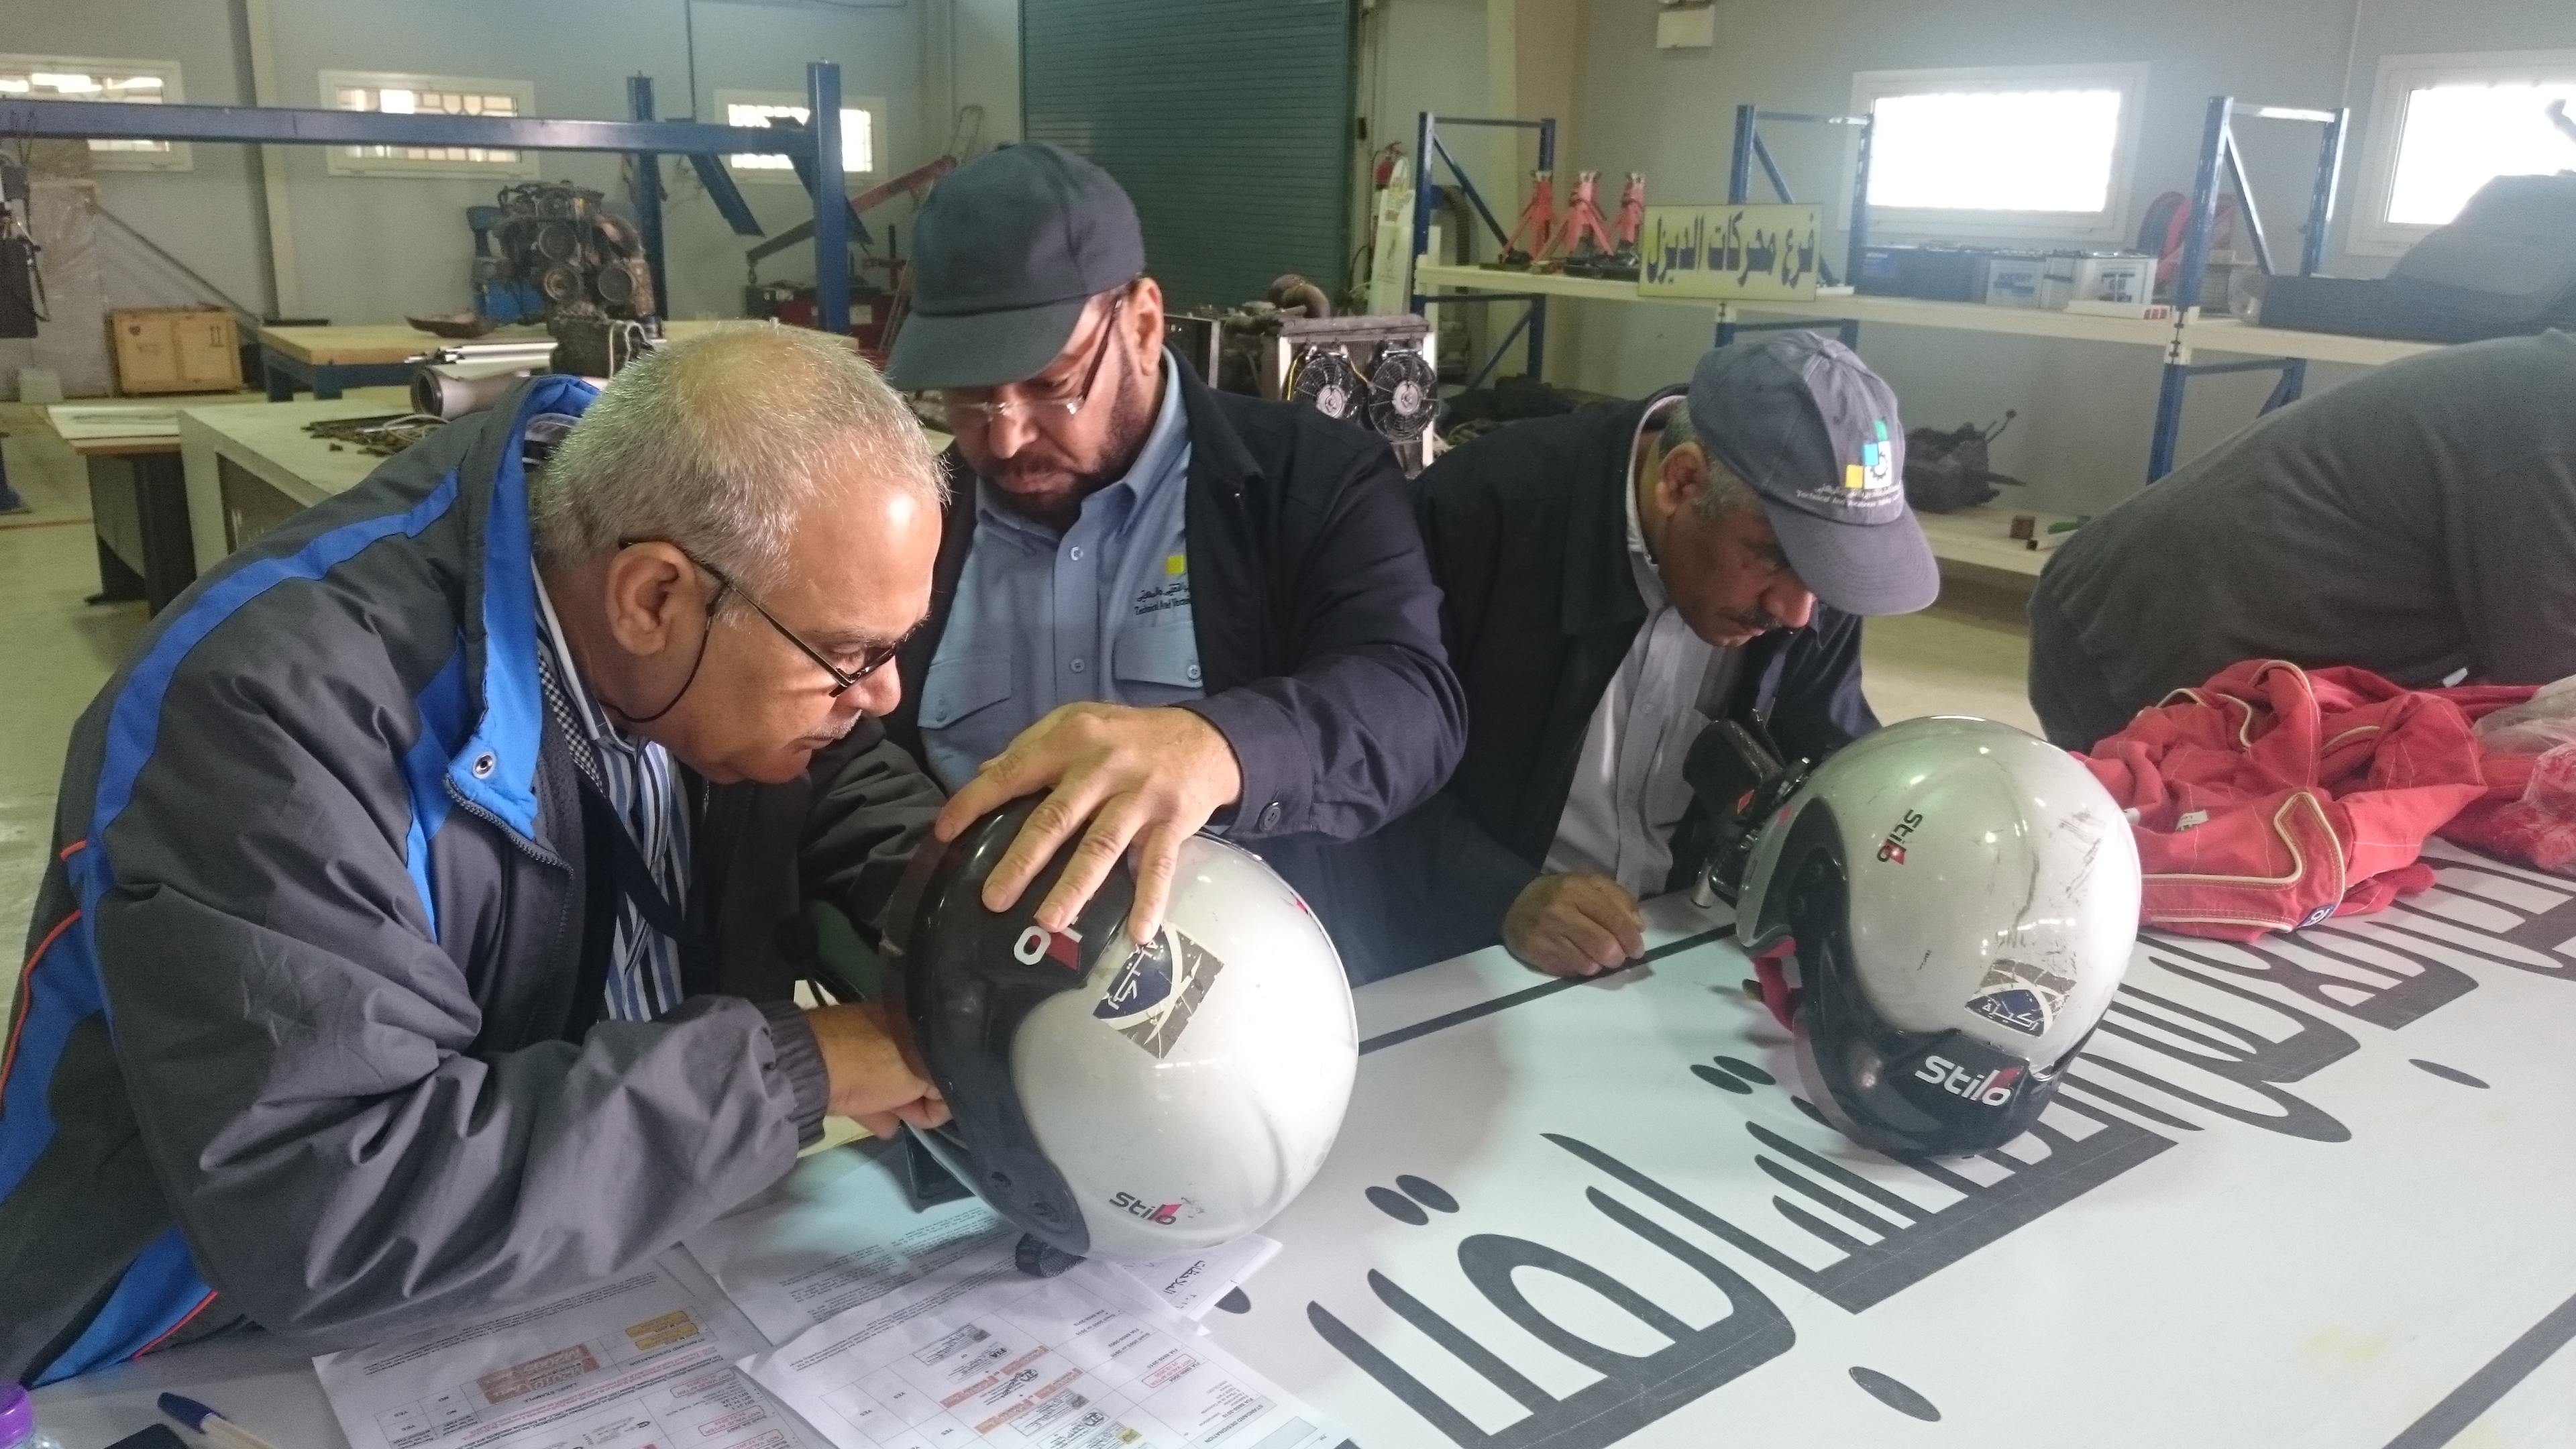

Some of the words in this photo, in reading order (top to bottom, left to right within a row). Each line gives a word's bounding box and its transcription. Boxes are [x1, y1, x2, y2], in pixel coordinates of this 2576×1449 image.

[1646, 214, 1705, 284] الديزل
[1707, 209, 1776, 287] محركات
[1782, 213, 1814, 289] فرع
[1876, 809, 1923, 863] Stilo
[1915, 1055, 2011, 1106] Stilo
[1108, 1190, 1178, 1227] Stilo
[1163, 1260, 1205, 1294] الملاحظات
[629, 1349, 672, 1366] DESIGNATION
[672, 1337, 705, 1351] STANDARD
[523, 1390, 555, 1403] EXAMPLE
[555, 1383, 577, 1392] LABEL
[1236, 1404, 1263, 1421] STANDARD
[941, 1427, 953, 1436] YES
[1204, 1421, 1237, 1443] DESIGNATION
